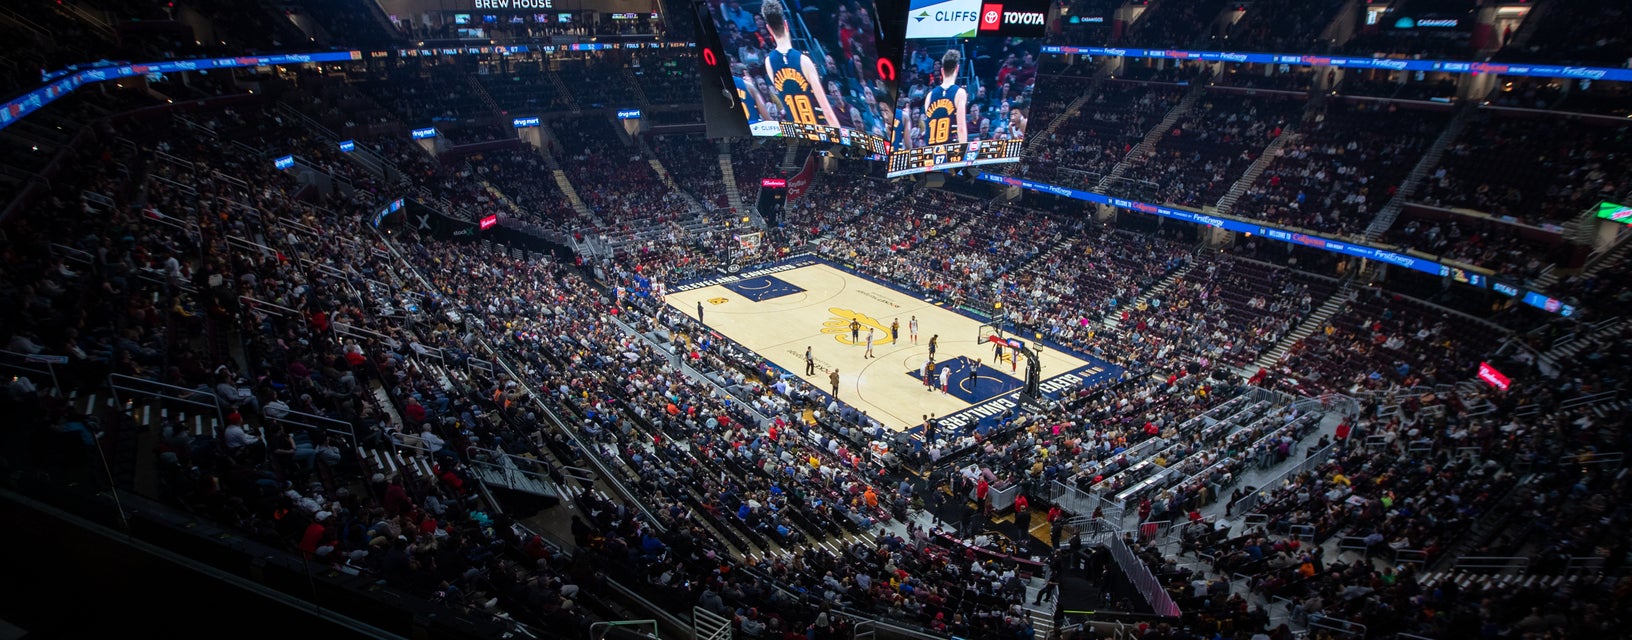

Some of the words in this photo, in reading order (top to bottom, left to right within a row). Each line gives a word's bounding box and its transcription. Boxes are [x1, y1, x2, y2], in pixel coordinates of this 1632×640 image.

[475, 0, 508, 8] BREW
[513, 0, 553, 8] HOUSE
[935, 11, 977, 22] CLIFFS
[1004, 12, 1045, 25] TOYOTA
[785, 94, 817, 124] 18
[928, 117, 950, 144] 18
[935, 156, 946, 164] 67
[966, 151, 976, 160] 52
[1193, 213, 1225, 227] FirstEnergy
[1374, 250, 1415, 267] FirstEnergy
[677, 275, 740, 292] CLEVELAND
[740, 264, 797, 279] CAVALIERS
